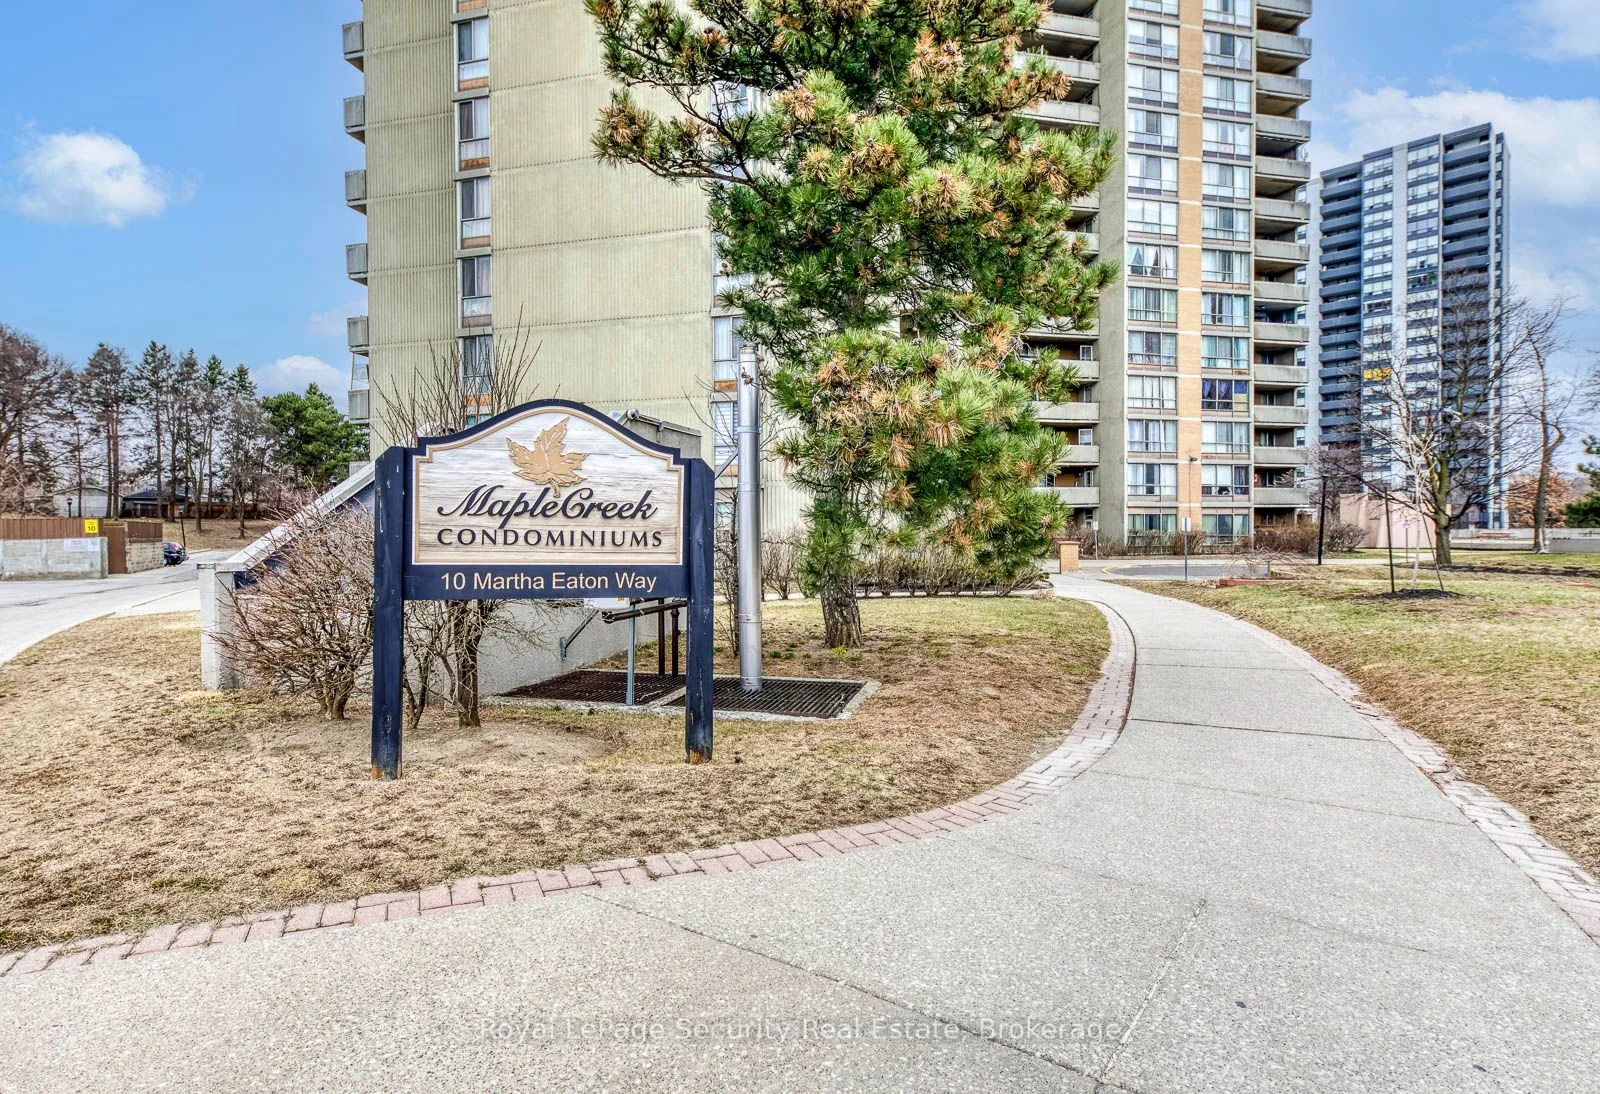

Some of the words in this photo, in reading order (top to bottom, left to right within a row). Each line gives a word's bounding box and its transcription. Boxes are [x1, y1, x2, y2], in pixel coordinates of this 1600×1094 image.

[437, 528, 663, 547] CONDOMINIUMS
[441, 572, 466, 590] 10
[473, 572, 545, 590] Martha
[552, 571, 609, 589] Eaton
[615, 571, 657, 593] Way
